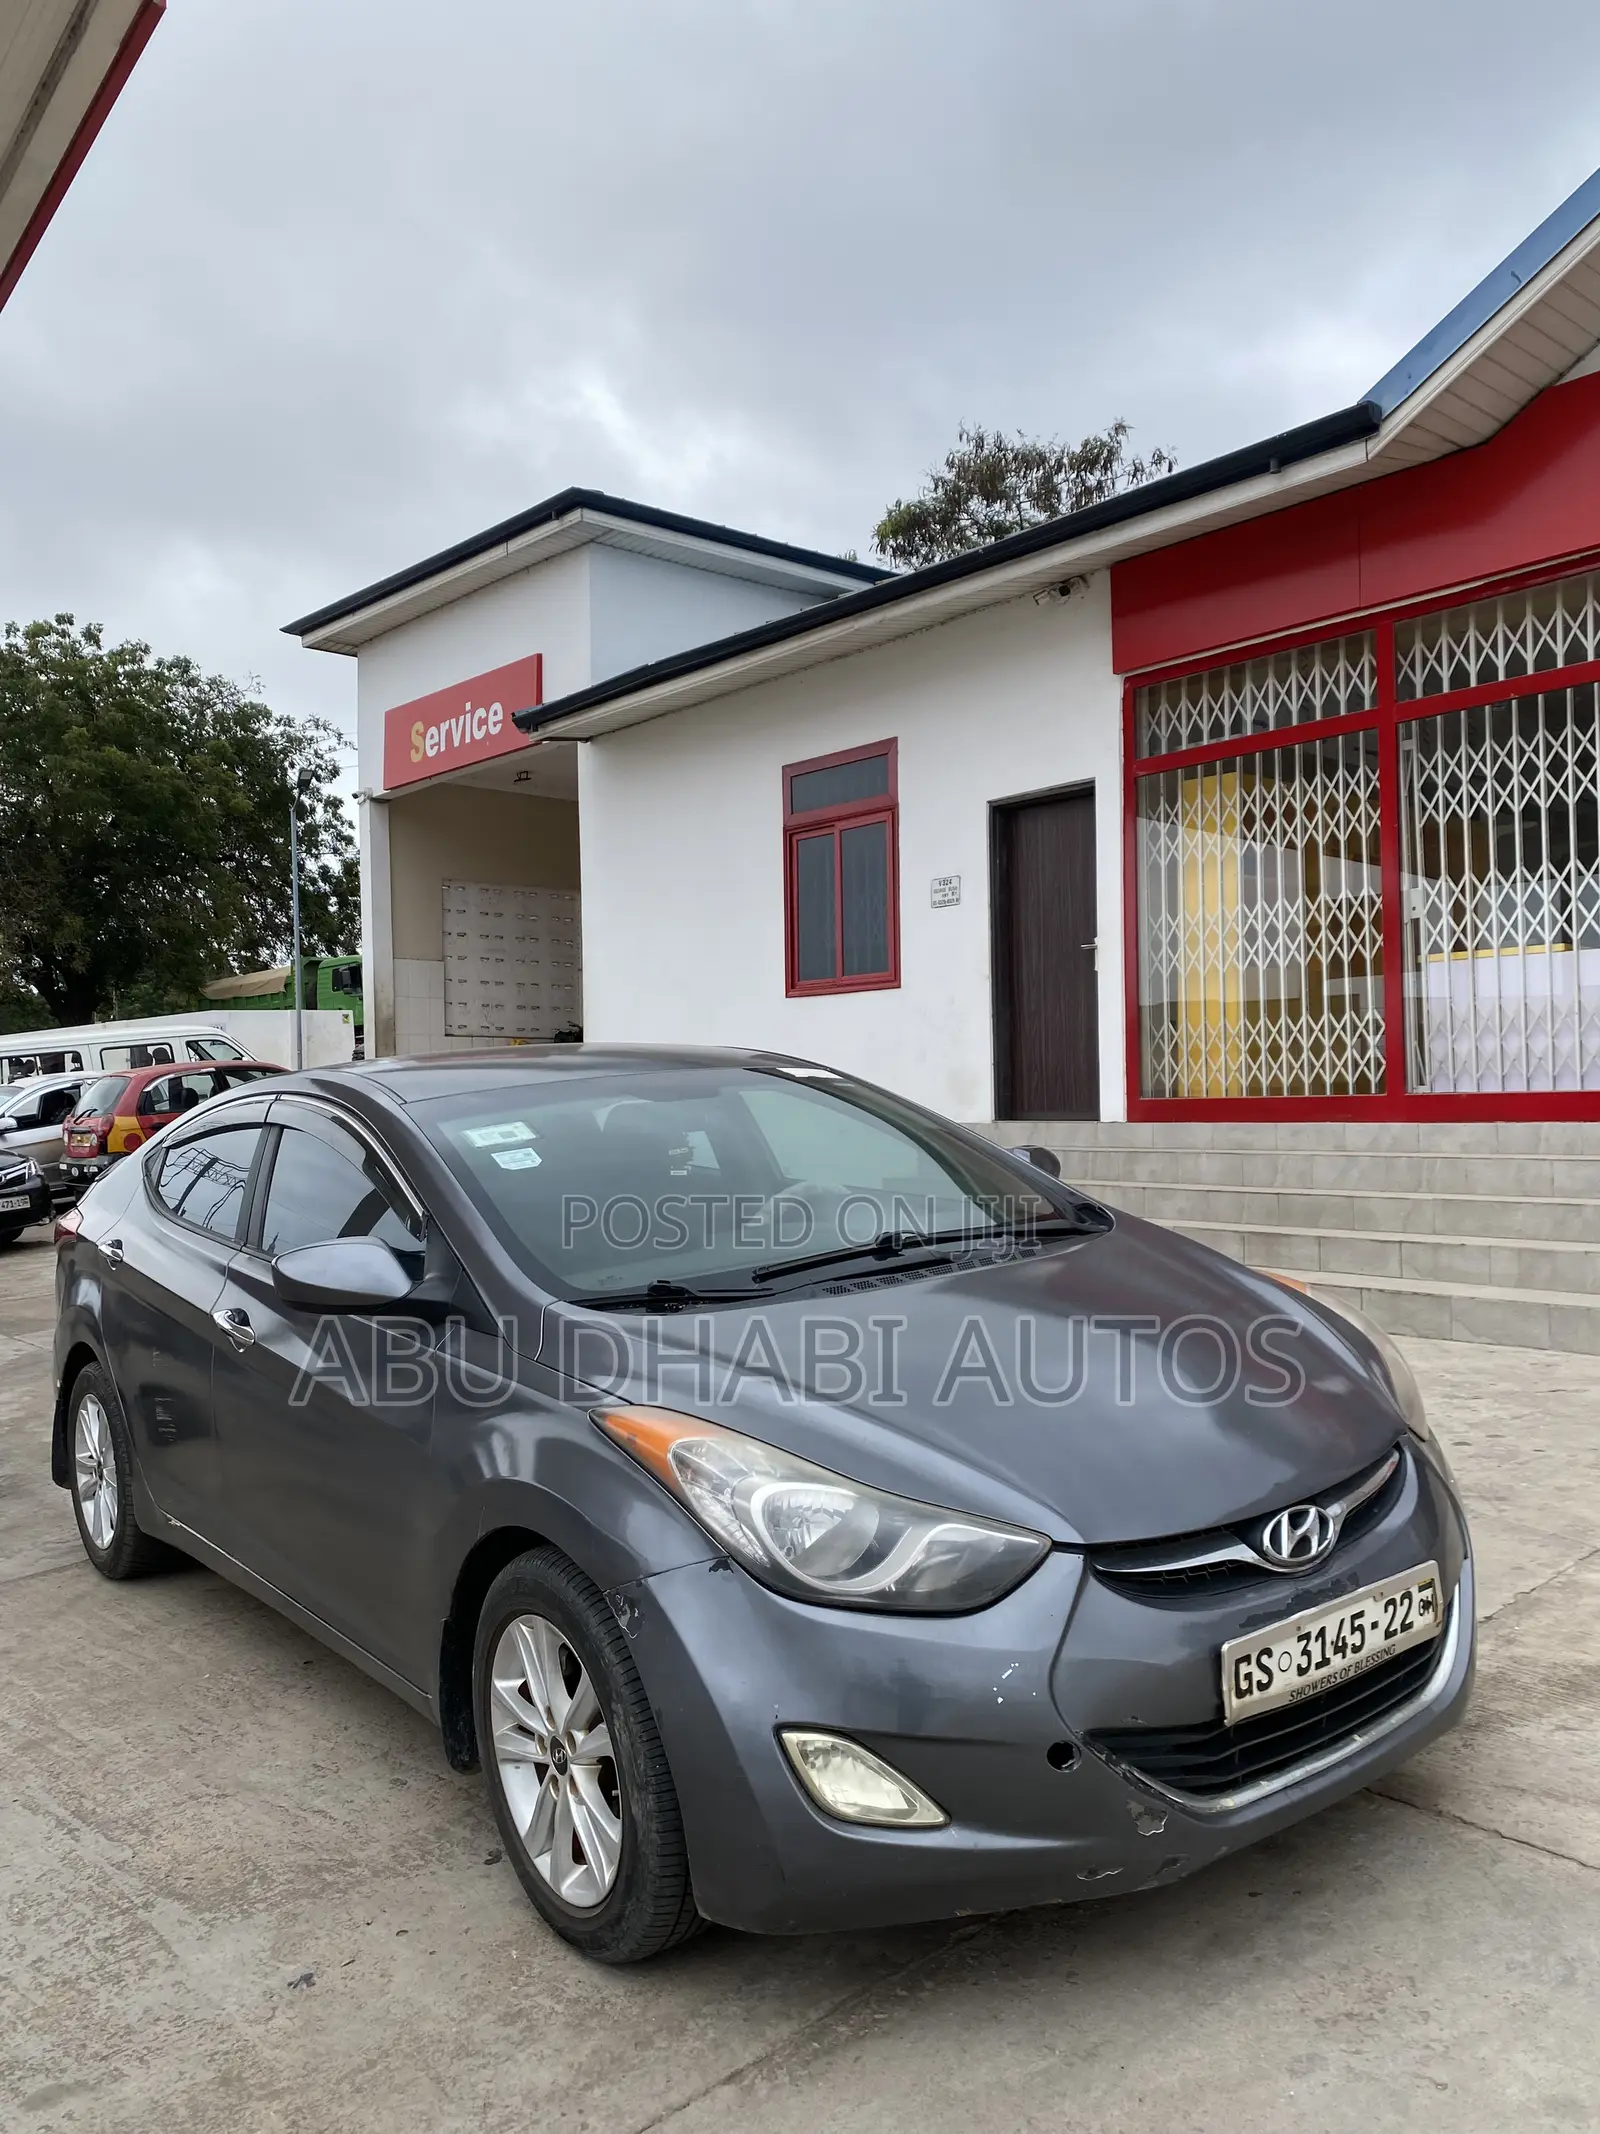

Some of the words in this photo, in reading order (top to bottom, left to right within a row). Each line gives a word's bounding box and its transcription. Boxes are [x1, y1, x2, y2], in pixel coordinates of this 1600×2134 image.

[410, 702, 503, 763] Service
[1234, 1647, 1274, 1700] GS
[1296, 1590, 1415, 1677] 3145-22
[1289, 1671, 1339, 1702] SHOWERS
[1339, 1664, 1354, 1680] OF
[1354, 1643, 1397, 1674] BLESSING
